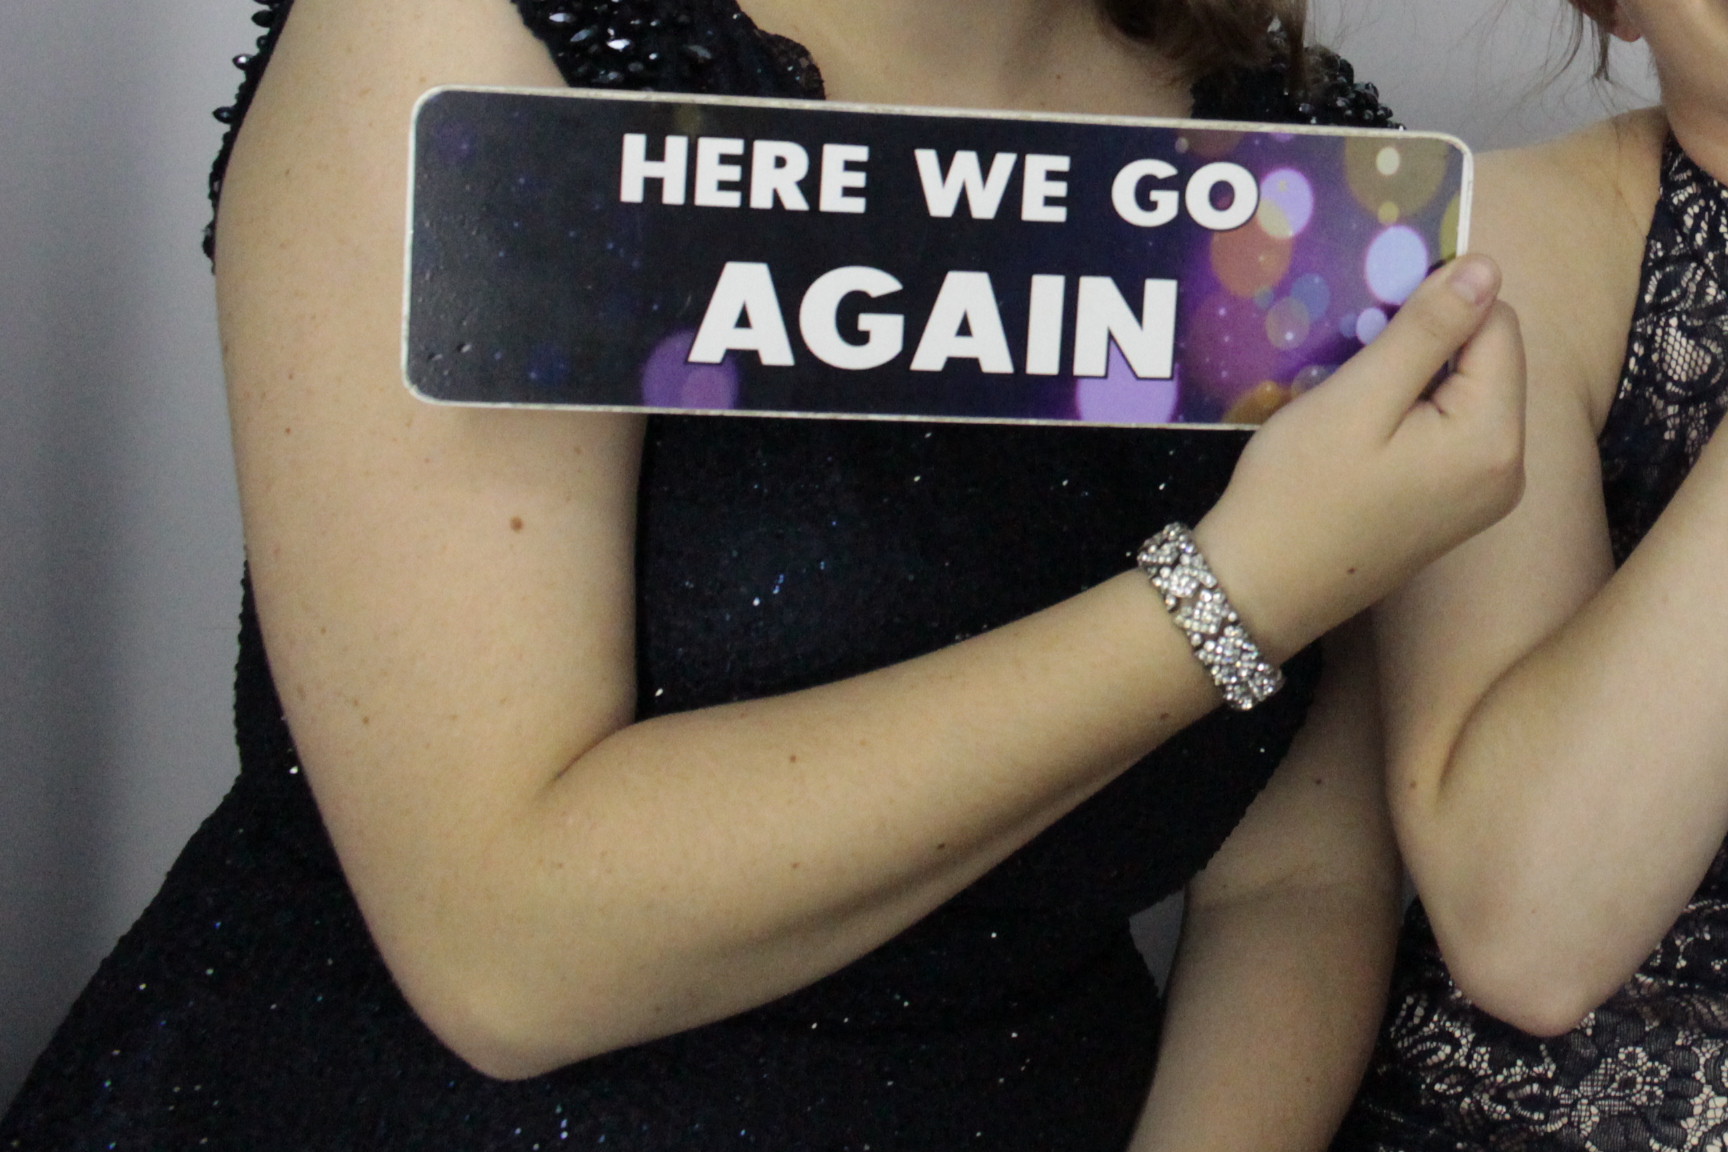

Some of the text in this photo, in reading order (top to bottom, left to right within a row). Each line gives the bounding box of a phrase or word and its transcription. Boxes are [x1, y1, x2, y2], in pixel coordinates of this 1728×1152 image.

[620, 133, 1259, 231] HERE WE GO
[687, 262, 1178, 380] AGAIN
